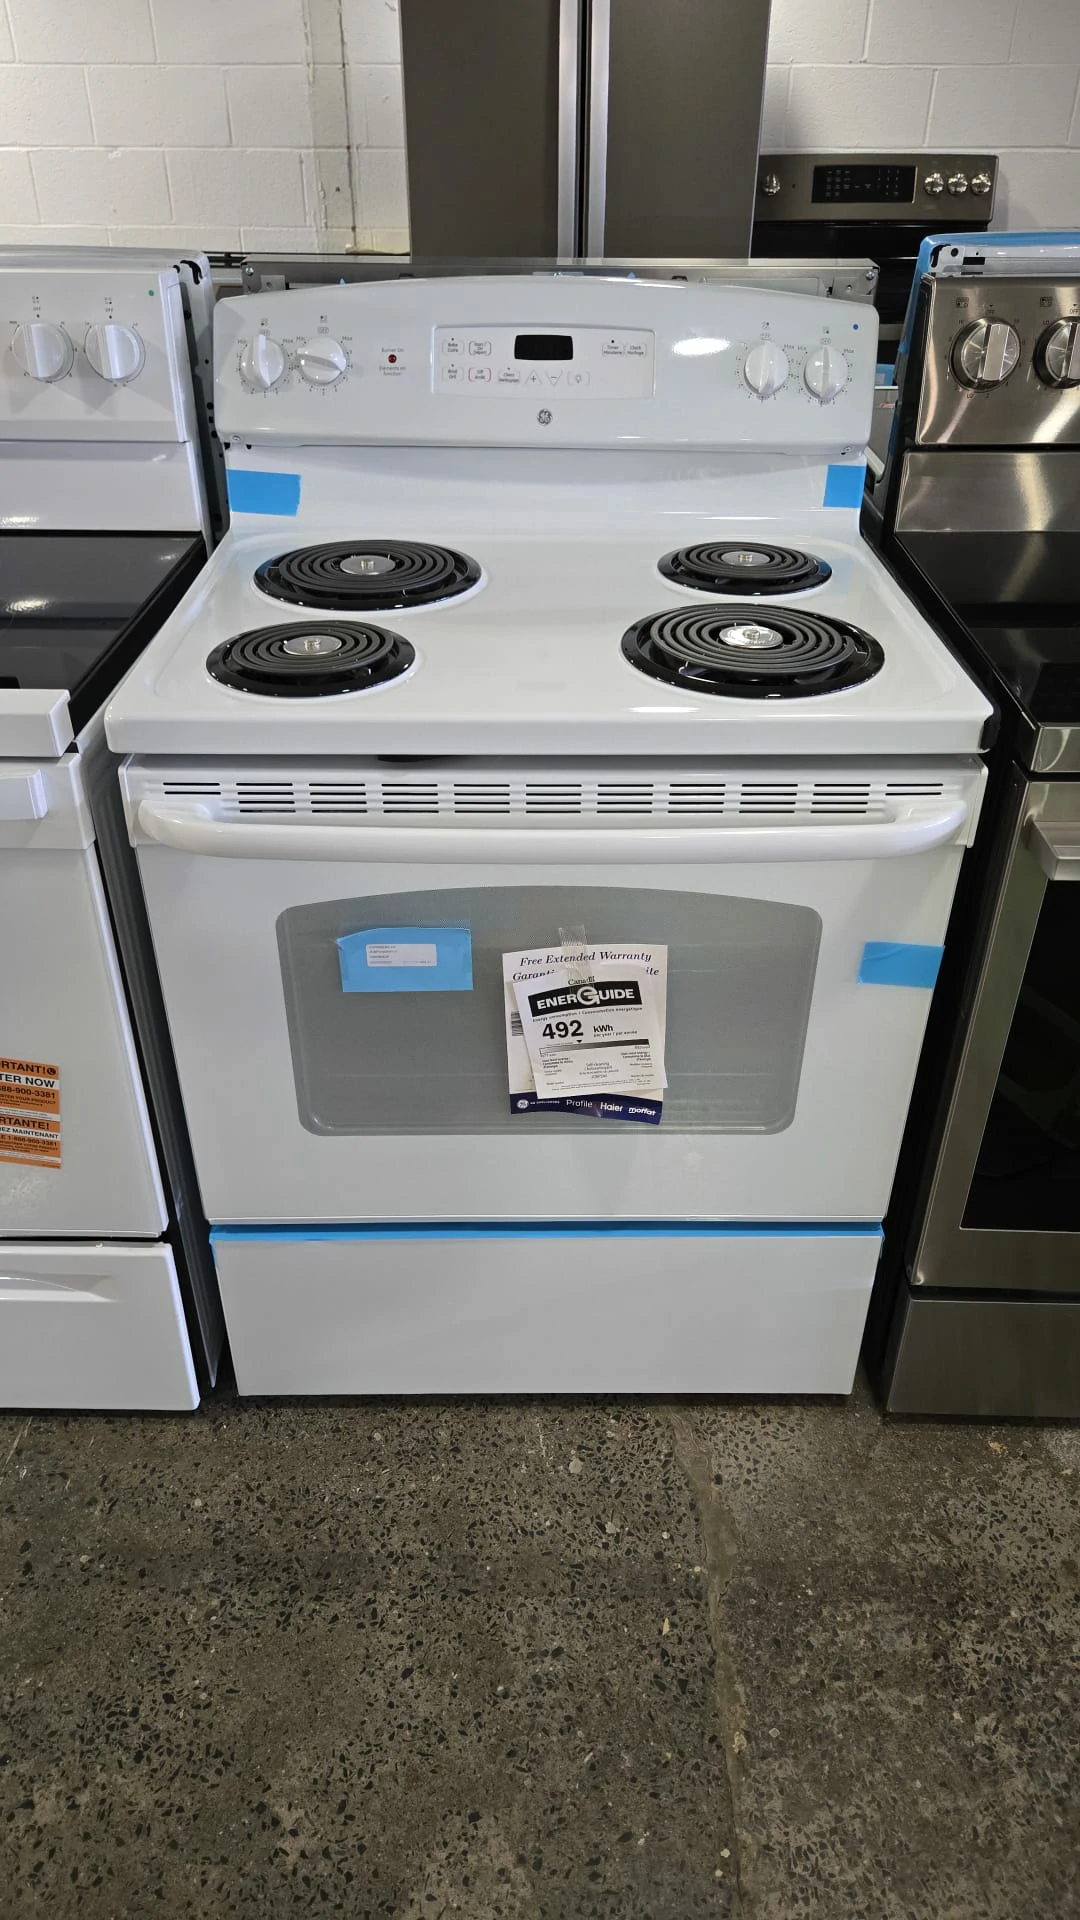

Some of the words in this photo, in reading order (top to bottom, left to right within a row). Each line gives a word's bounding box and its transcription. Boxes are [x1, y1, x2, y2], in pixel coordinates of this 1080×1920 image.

[519, 956, 543, 967] Free
[545, 951, 596, 964] Extended
[599, 951, 652, 963] Warranty
[542, 1019, 584, 1040] 492
[592, 1024, 614, 1034] kWh
[25, 1076, 55, 1088] NOW
[566, 1098, 593, 1109] Profile
[599, 1101, 624, 1113] Haier
[12, 1128, 59, 1139] MAINTENANT
